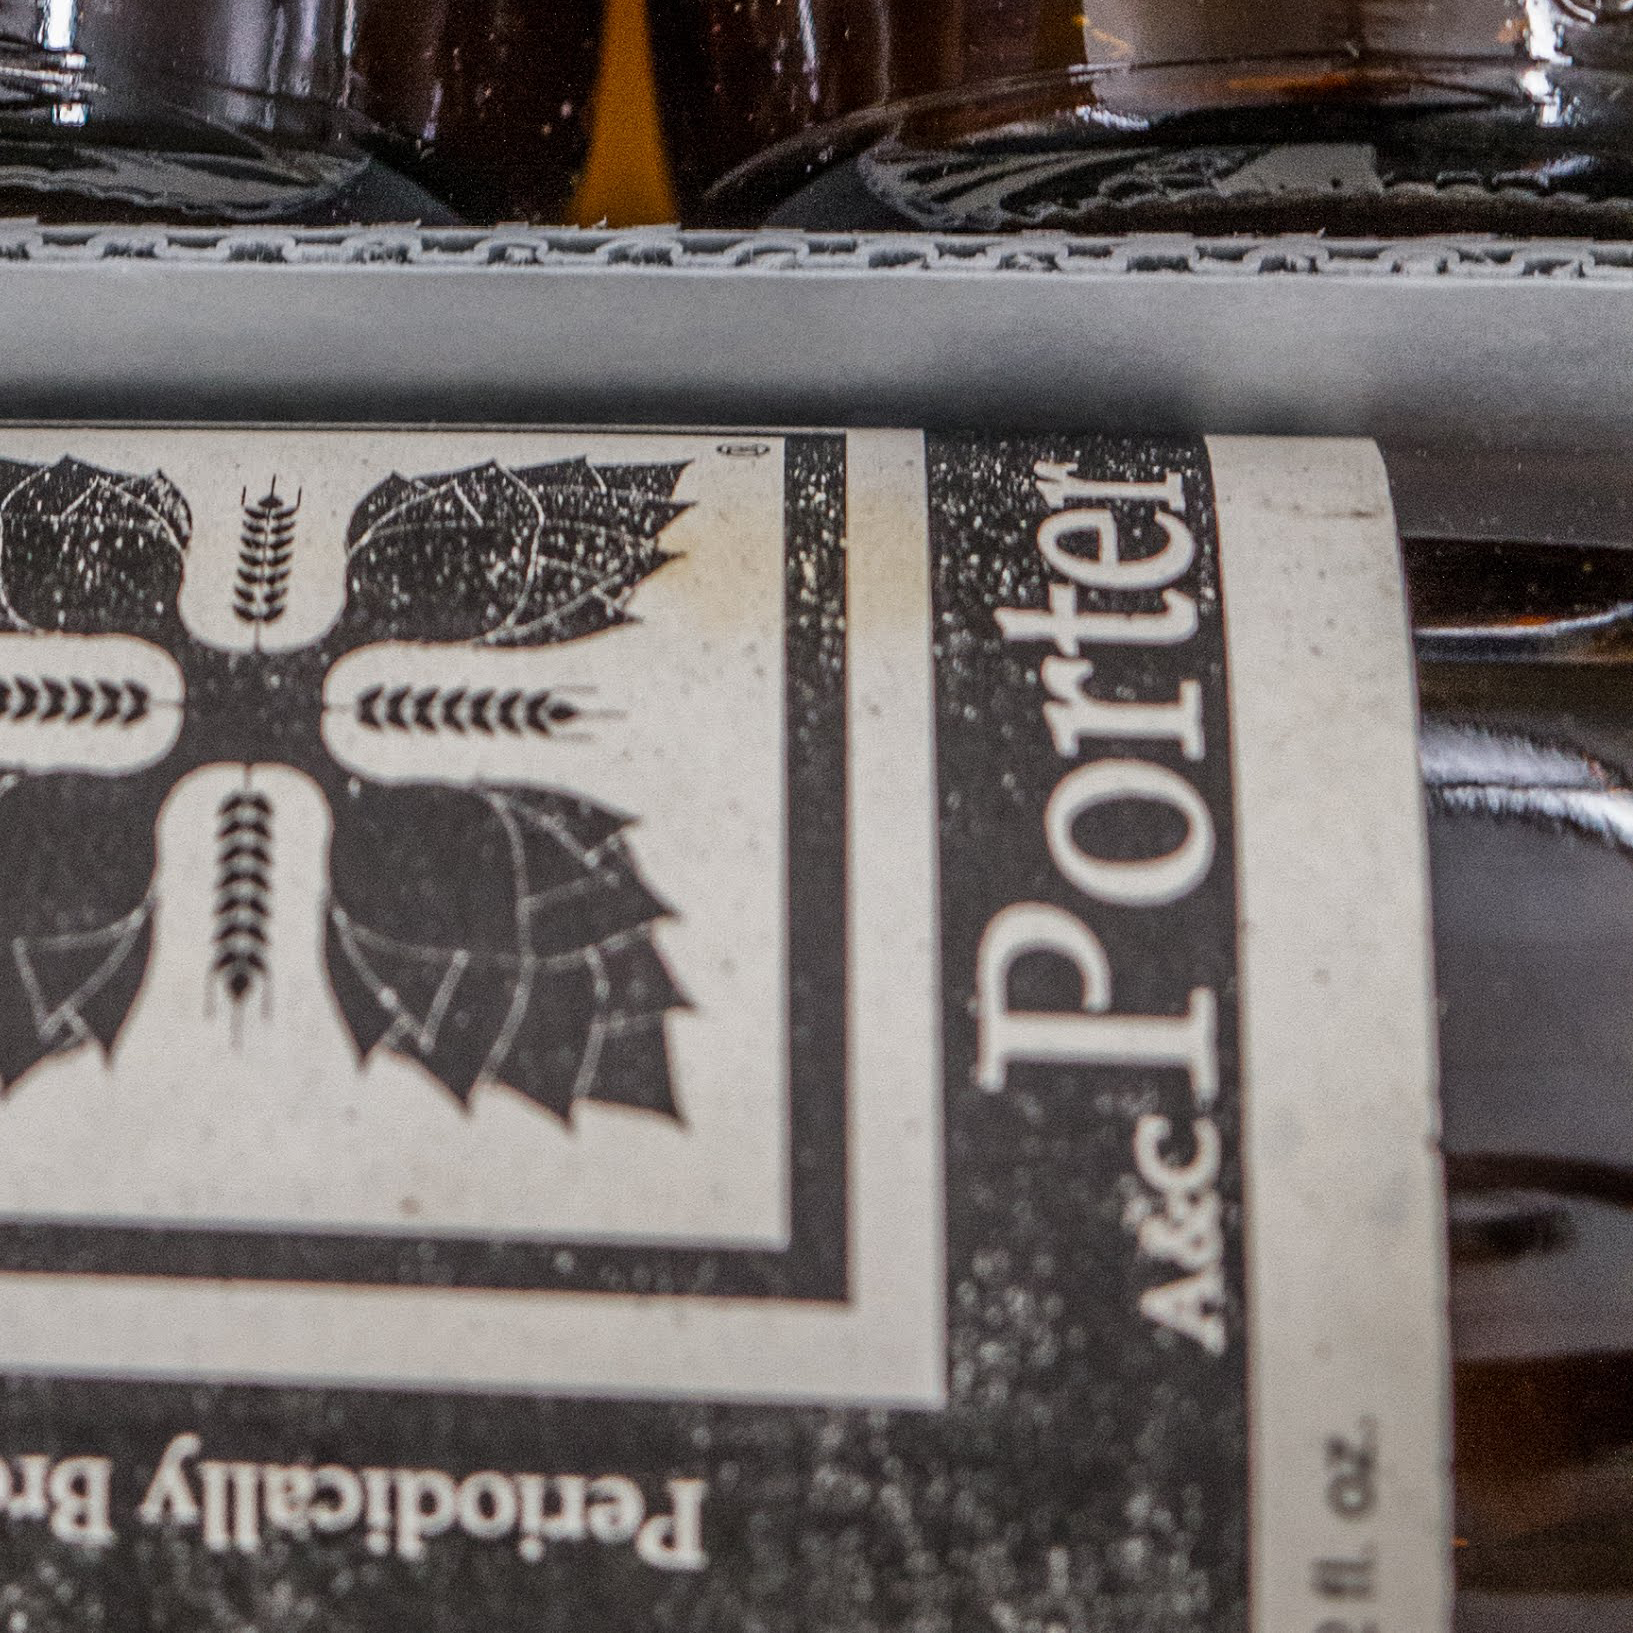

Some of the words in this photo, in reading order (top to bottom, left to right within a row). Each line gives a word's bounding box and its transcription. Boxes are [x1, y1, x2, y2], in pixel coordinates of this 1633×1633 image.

[971, 459, 1220, 1104] Porter
[1131, 1112, 1228, 1358] A&C
[137, 1432, 708, 1573] Periodically
